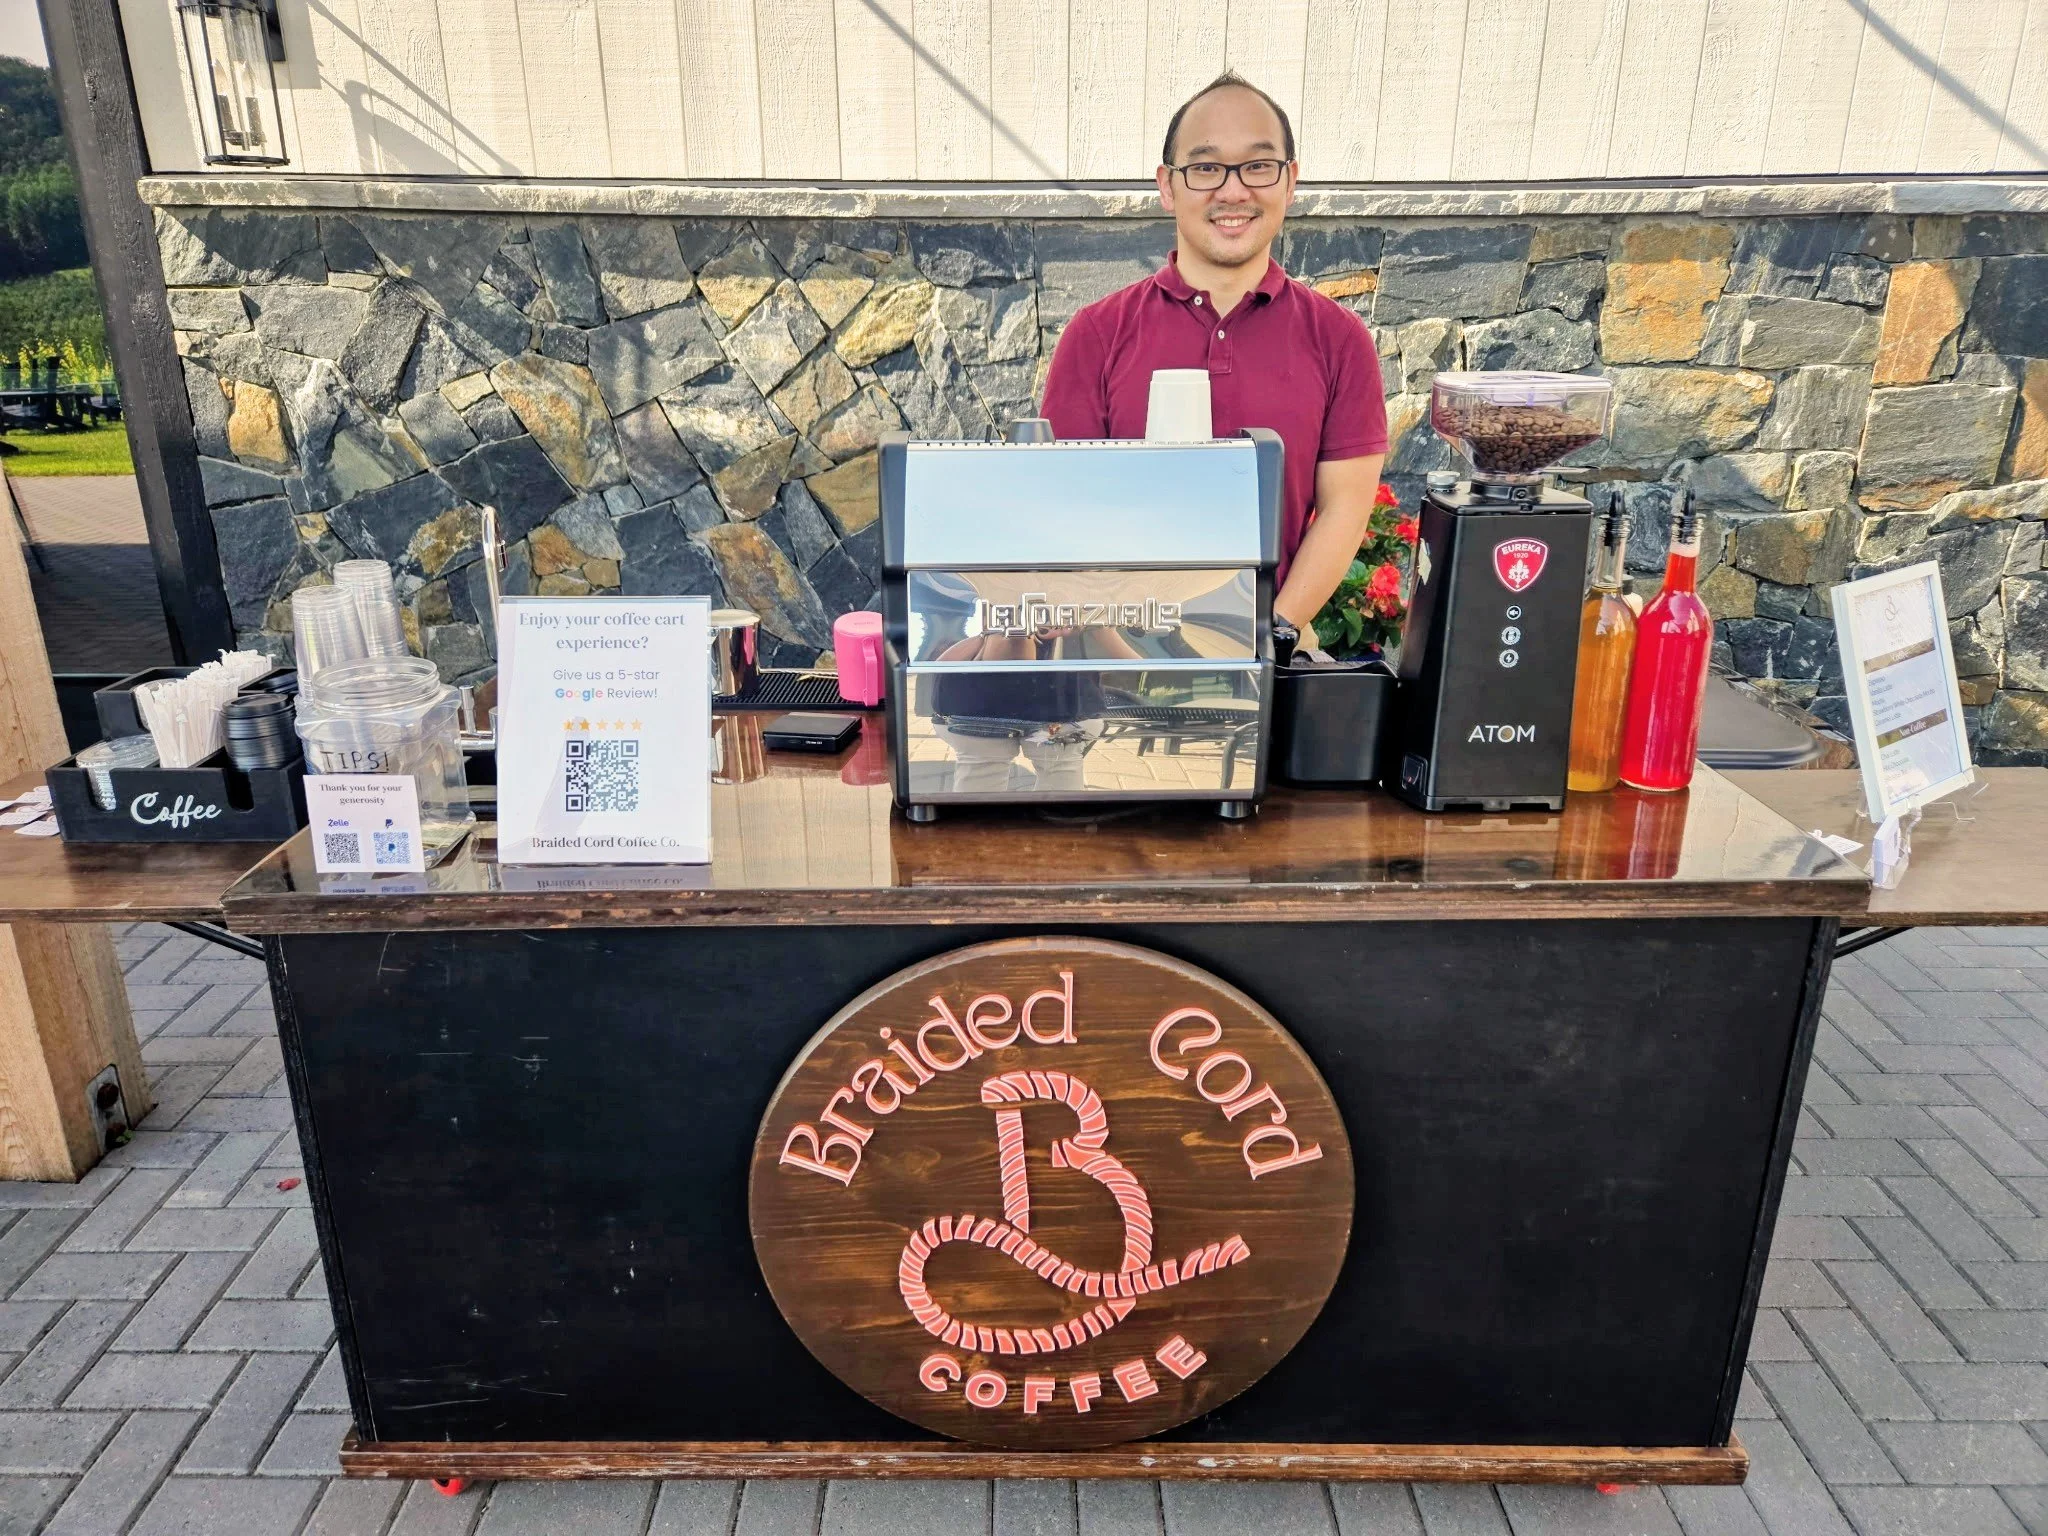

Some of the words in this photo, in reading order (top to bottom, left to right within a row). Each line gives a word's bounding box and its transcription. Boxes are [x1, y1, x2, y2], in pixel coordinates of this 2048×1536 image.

[1501, 543, 1541, 555] EUREKA
[519, 612, 562, 629] Enjoy
[565, 614, 600, 629] your
[604, 612, 651, 626] coffee
[654, 613, 685, 626] cart
[556, 636, 649, 652] experience?
[553, 669, 582, 680] Give
[586, 672, 601, 680] us
[605, 672, 614, 680] a
[618, 669, 660, 680] 5-star
[555, 688, 604, 701] Google
[607, 688, 658, 699] Review!
[1467, 724, 1536, 743] ATOM
[320, 750, 390, 771] TIPS!
[319, 784, 348, 792] Thank
[350, 786, 366, 794] you
[367, 784, 380, 792] for
[381, 785, 402, 793] your
[340, 796, 386, 806] generosity
[130, 792, 222, 828] Coffee
[328, 818, 350, 828] Zelle
[532, 836, 581, 848] Braided
[584, 836, 614, 848] Cord
[617, 836, 657, 848] Coffee
[660, 836, 680, 848] Co.
[778, 971, 1078, 1187] Braided
[1149, 1007, 1323, 1181] Cord
[919, 1333, 1208, 1414] COFFEE
